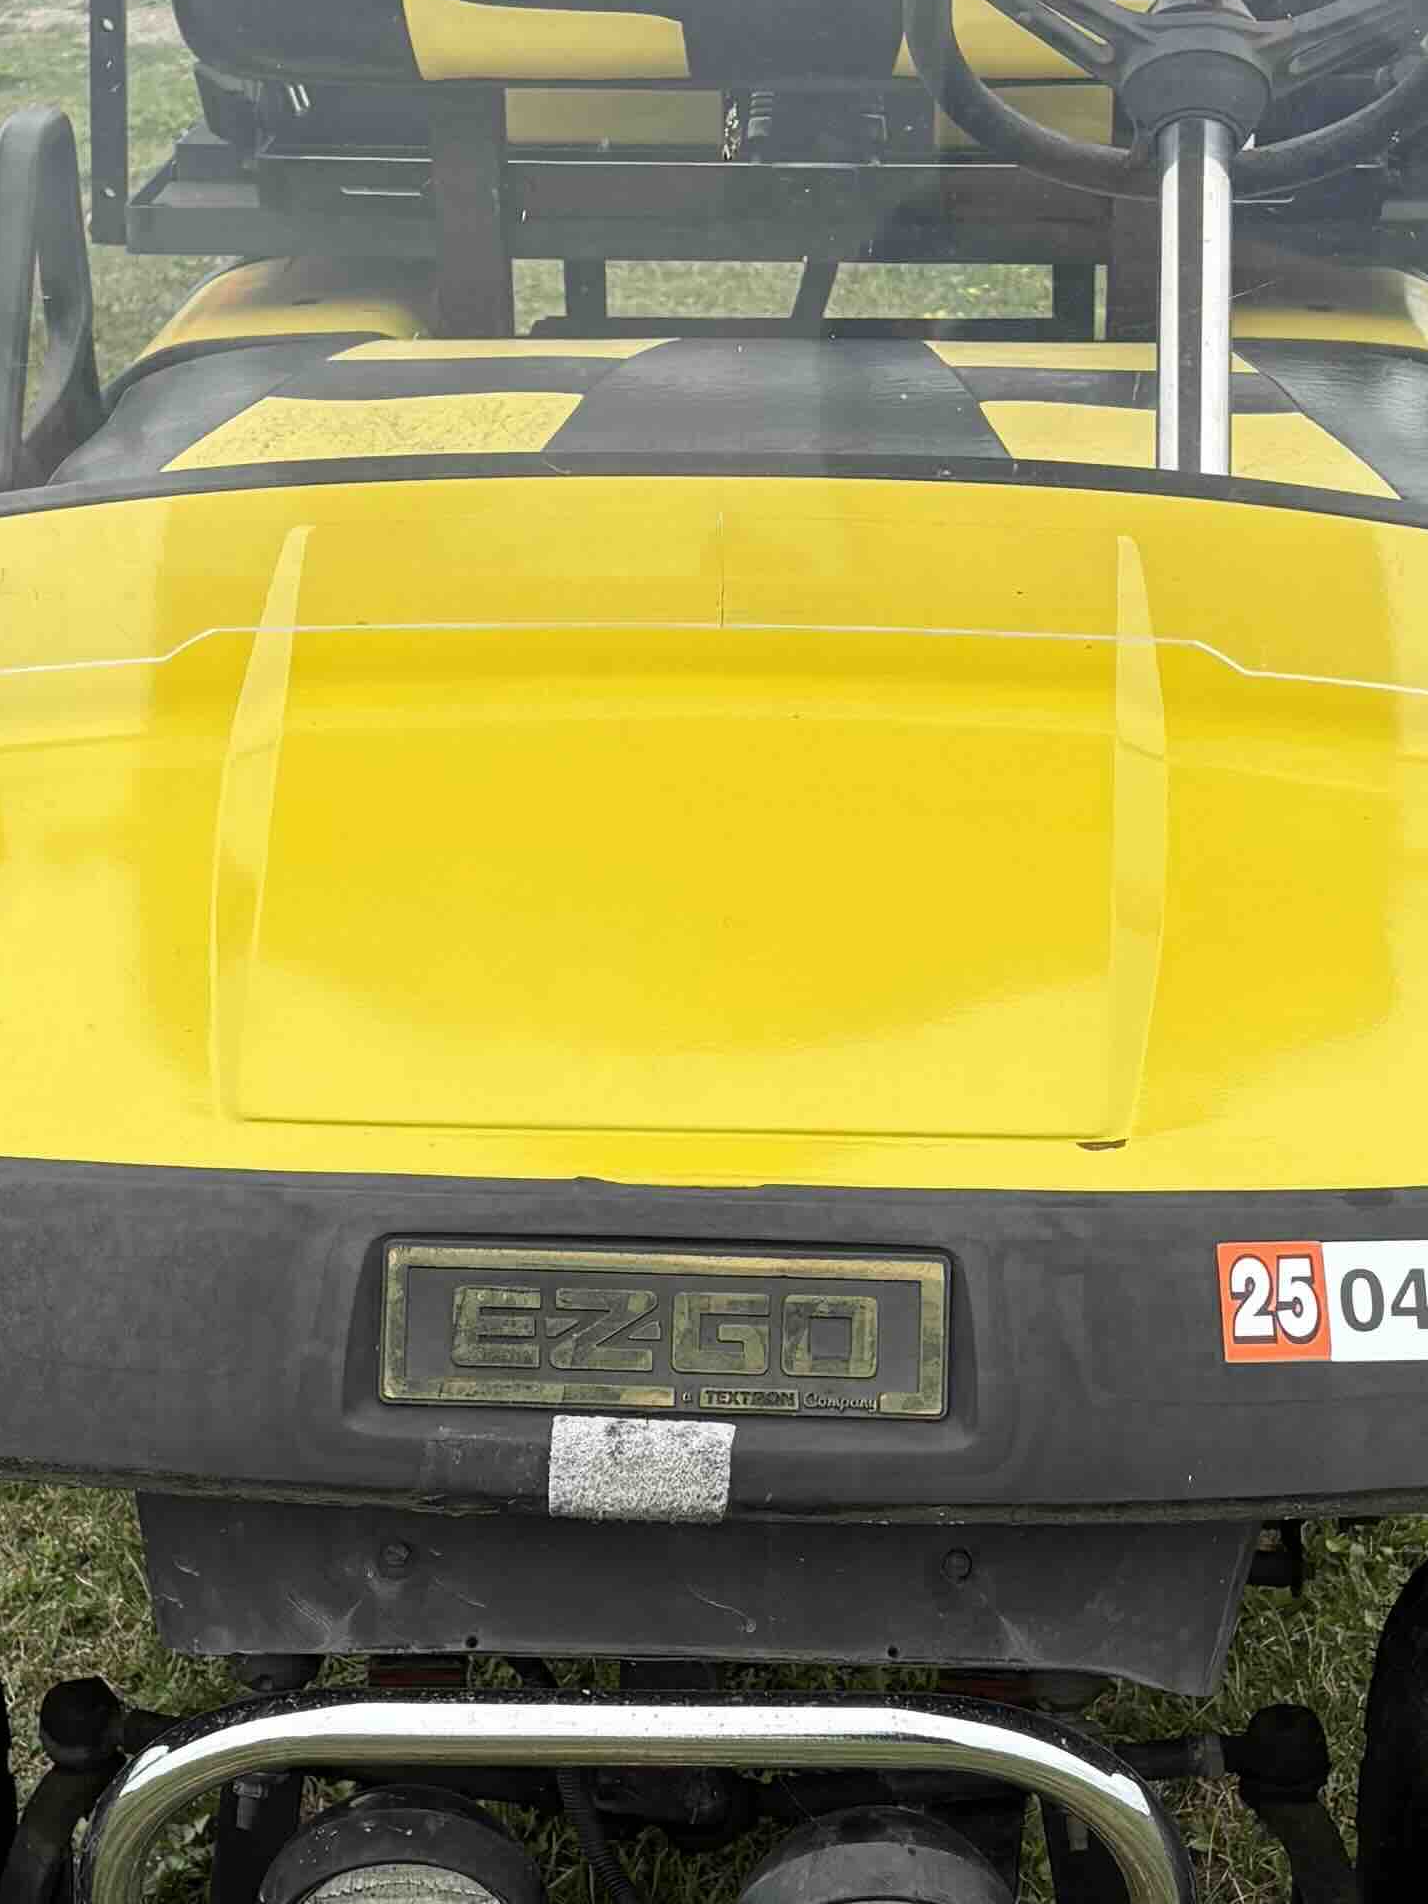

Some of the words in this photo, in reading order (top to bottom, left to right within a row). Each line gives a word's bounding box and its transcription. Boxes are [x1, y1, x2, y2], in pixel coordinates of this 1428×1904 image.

[1228, 1252, 1321, 1345] 25
[705, 1390, 796, 1408] TEXTRON
[803, 1392, 878, 1413] Company
